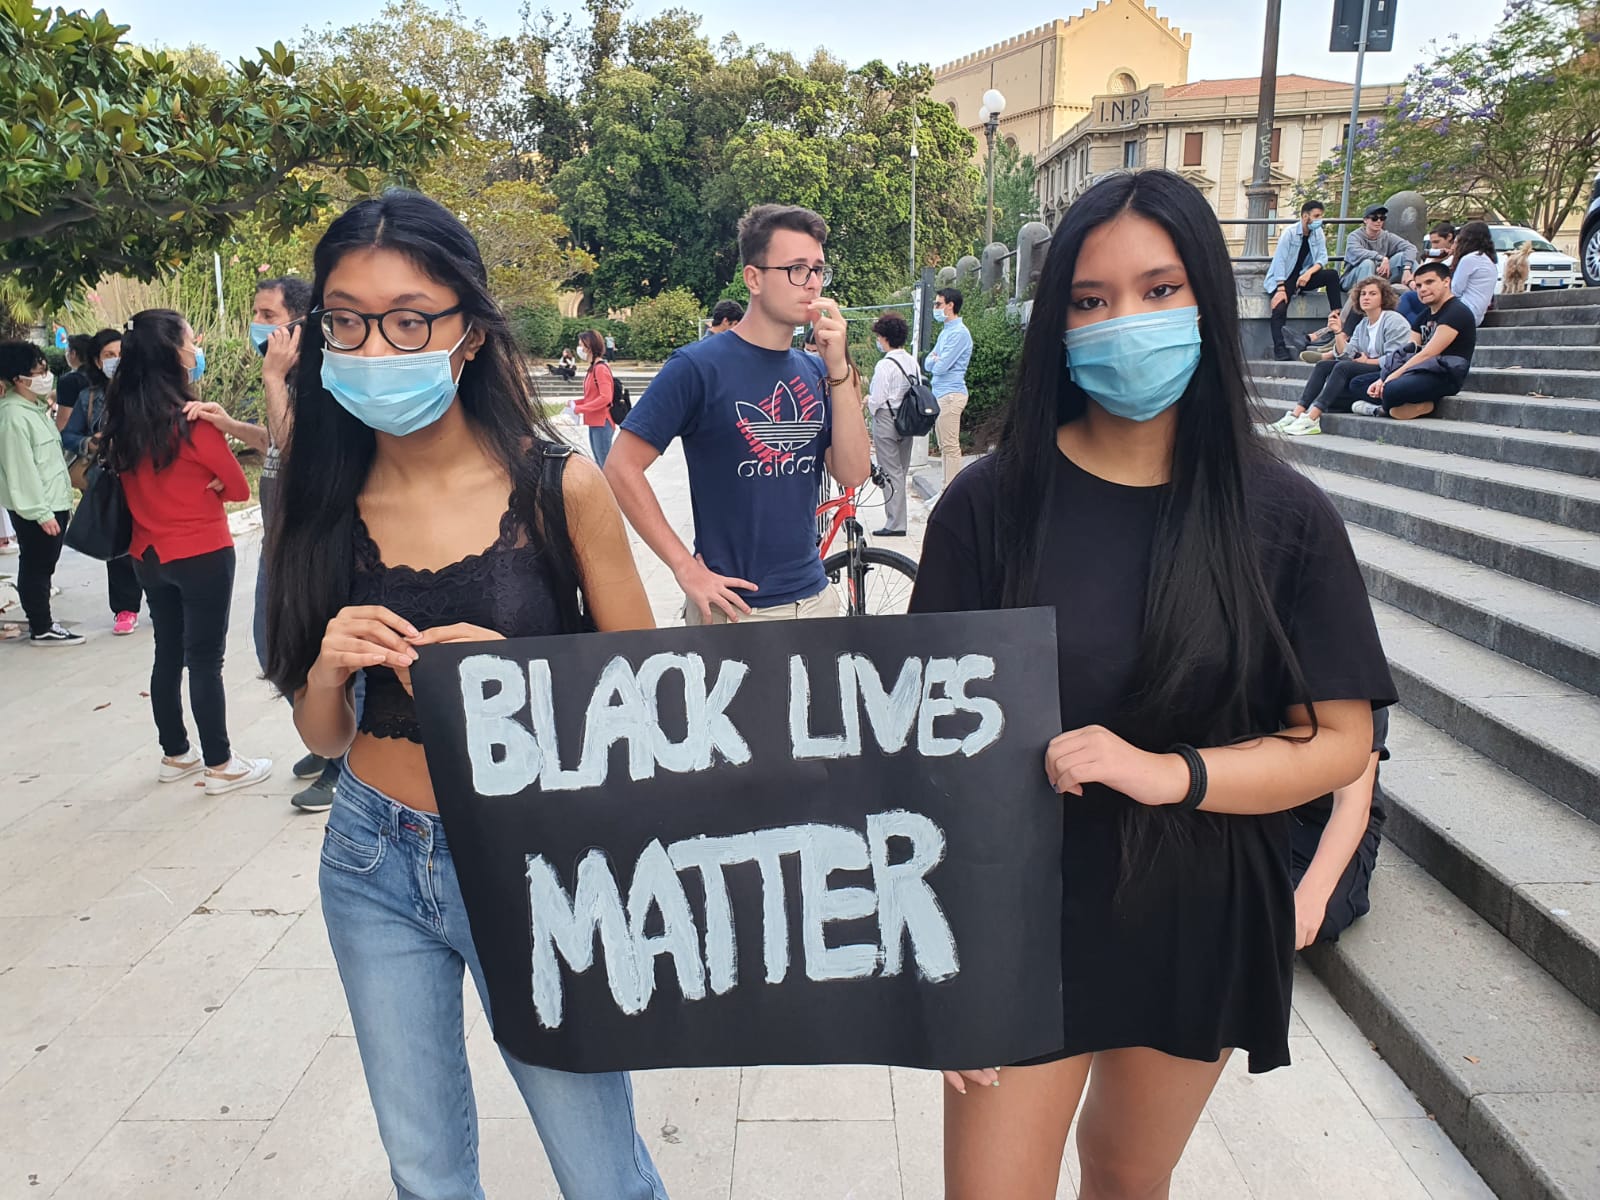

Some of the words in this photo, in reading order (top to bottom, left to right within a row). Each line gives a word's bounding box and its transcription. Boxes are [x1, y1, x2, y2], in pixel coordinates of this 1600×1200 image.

[458, 652, 752, 797] BLACK
[788, 652, 1005, 758] LIVES
[524, 809, 961, 1030] MATTER
